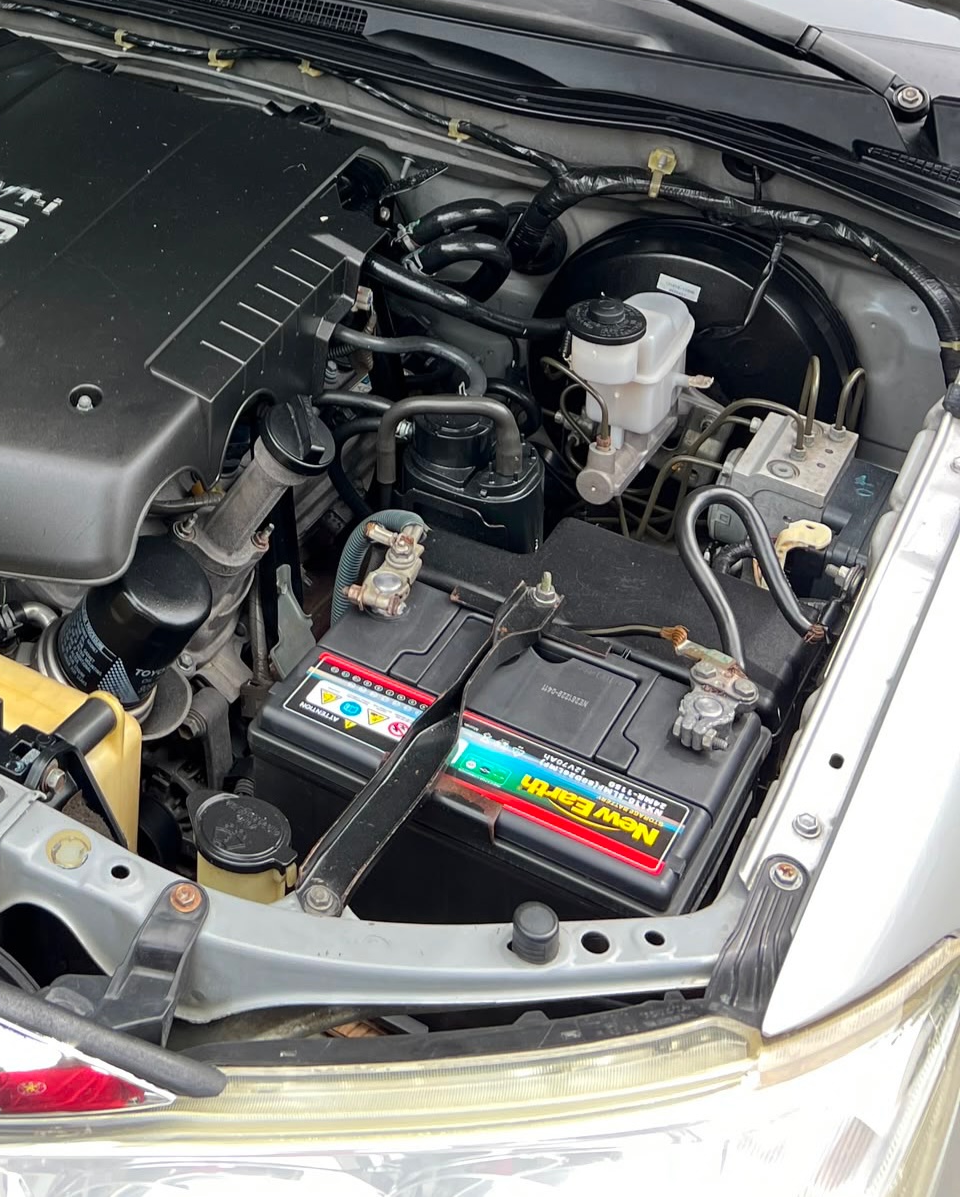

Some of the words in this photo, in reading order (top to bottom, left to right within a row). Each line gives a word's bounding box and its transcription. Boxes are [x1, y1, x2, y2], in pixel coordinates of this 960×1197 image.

[299, 701, 340, 722] ATTENTION
[543, 753, 587, 776] 12V70Ah
[521, 774, 596, 818] Earth
[596, 795, 628, 814] BATTERY
[593, 806, 660, 847] New
[628, 808, 664, 827] STORAGE
